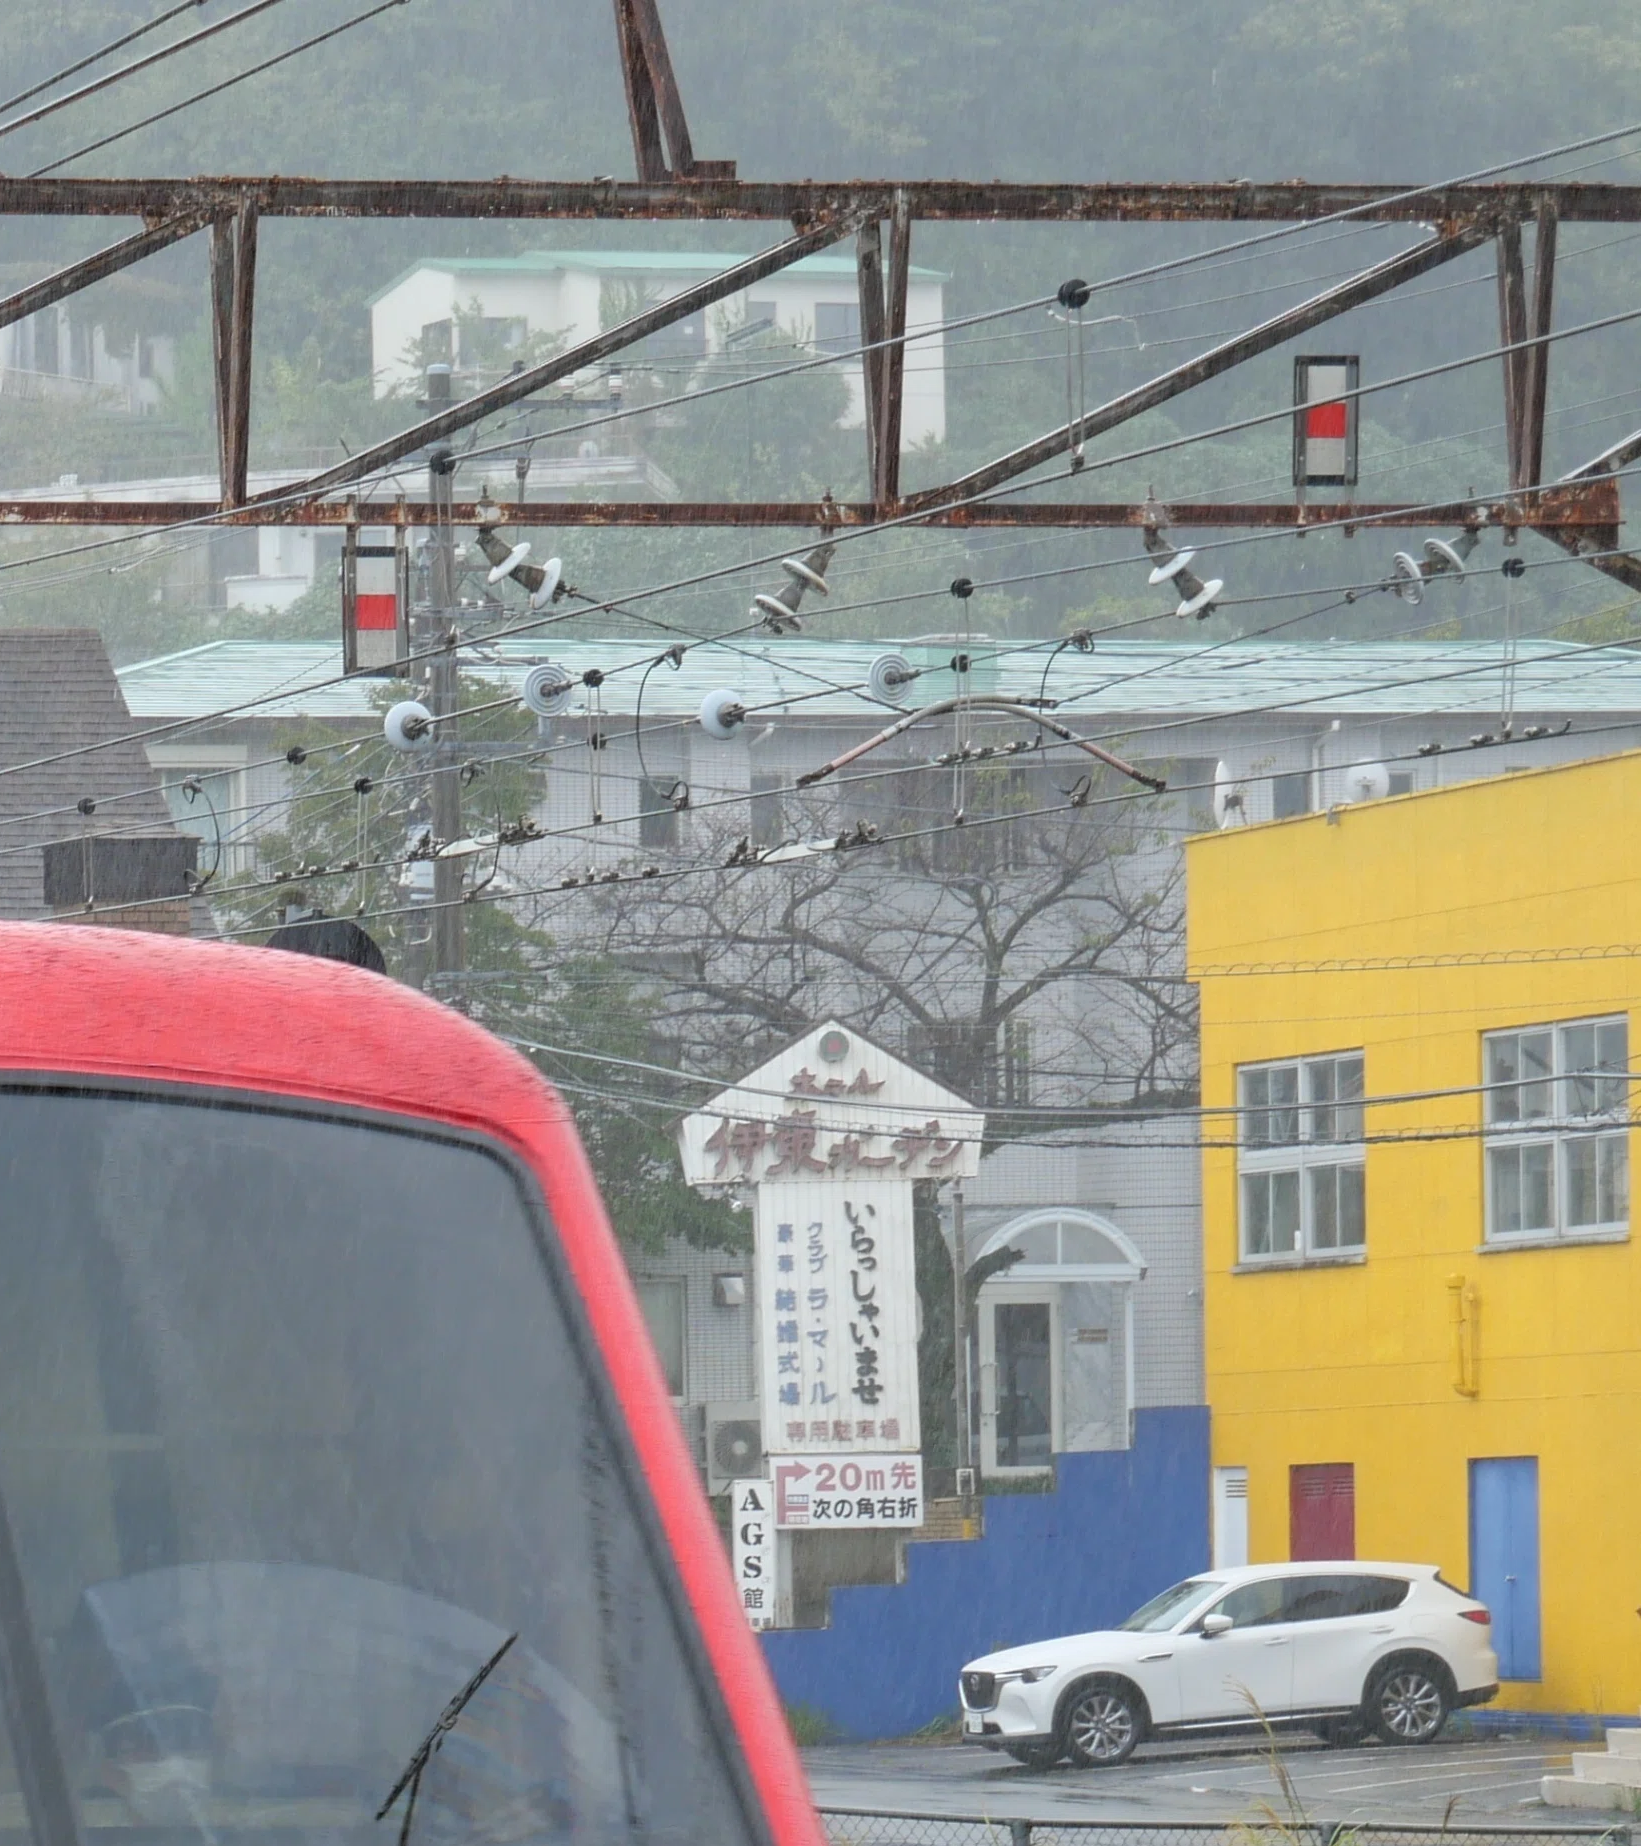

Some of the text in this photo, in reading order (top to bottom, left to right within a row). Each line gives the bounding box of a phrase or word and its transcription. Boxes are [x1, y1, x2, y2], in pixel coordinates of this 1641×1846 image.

[789, 1067, 886, 1099] ホテル
[703, 1109, 964, 1176] 伊東ガーデン
[843, 1200, 884, 1405] いらっしゃいませ
[812, 1497, 918, 1519] 次の角右折
